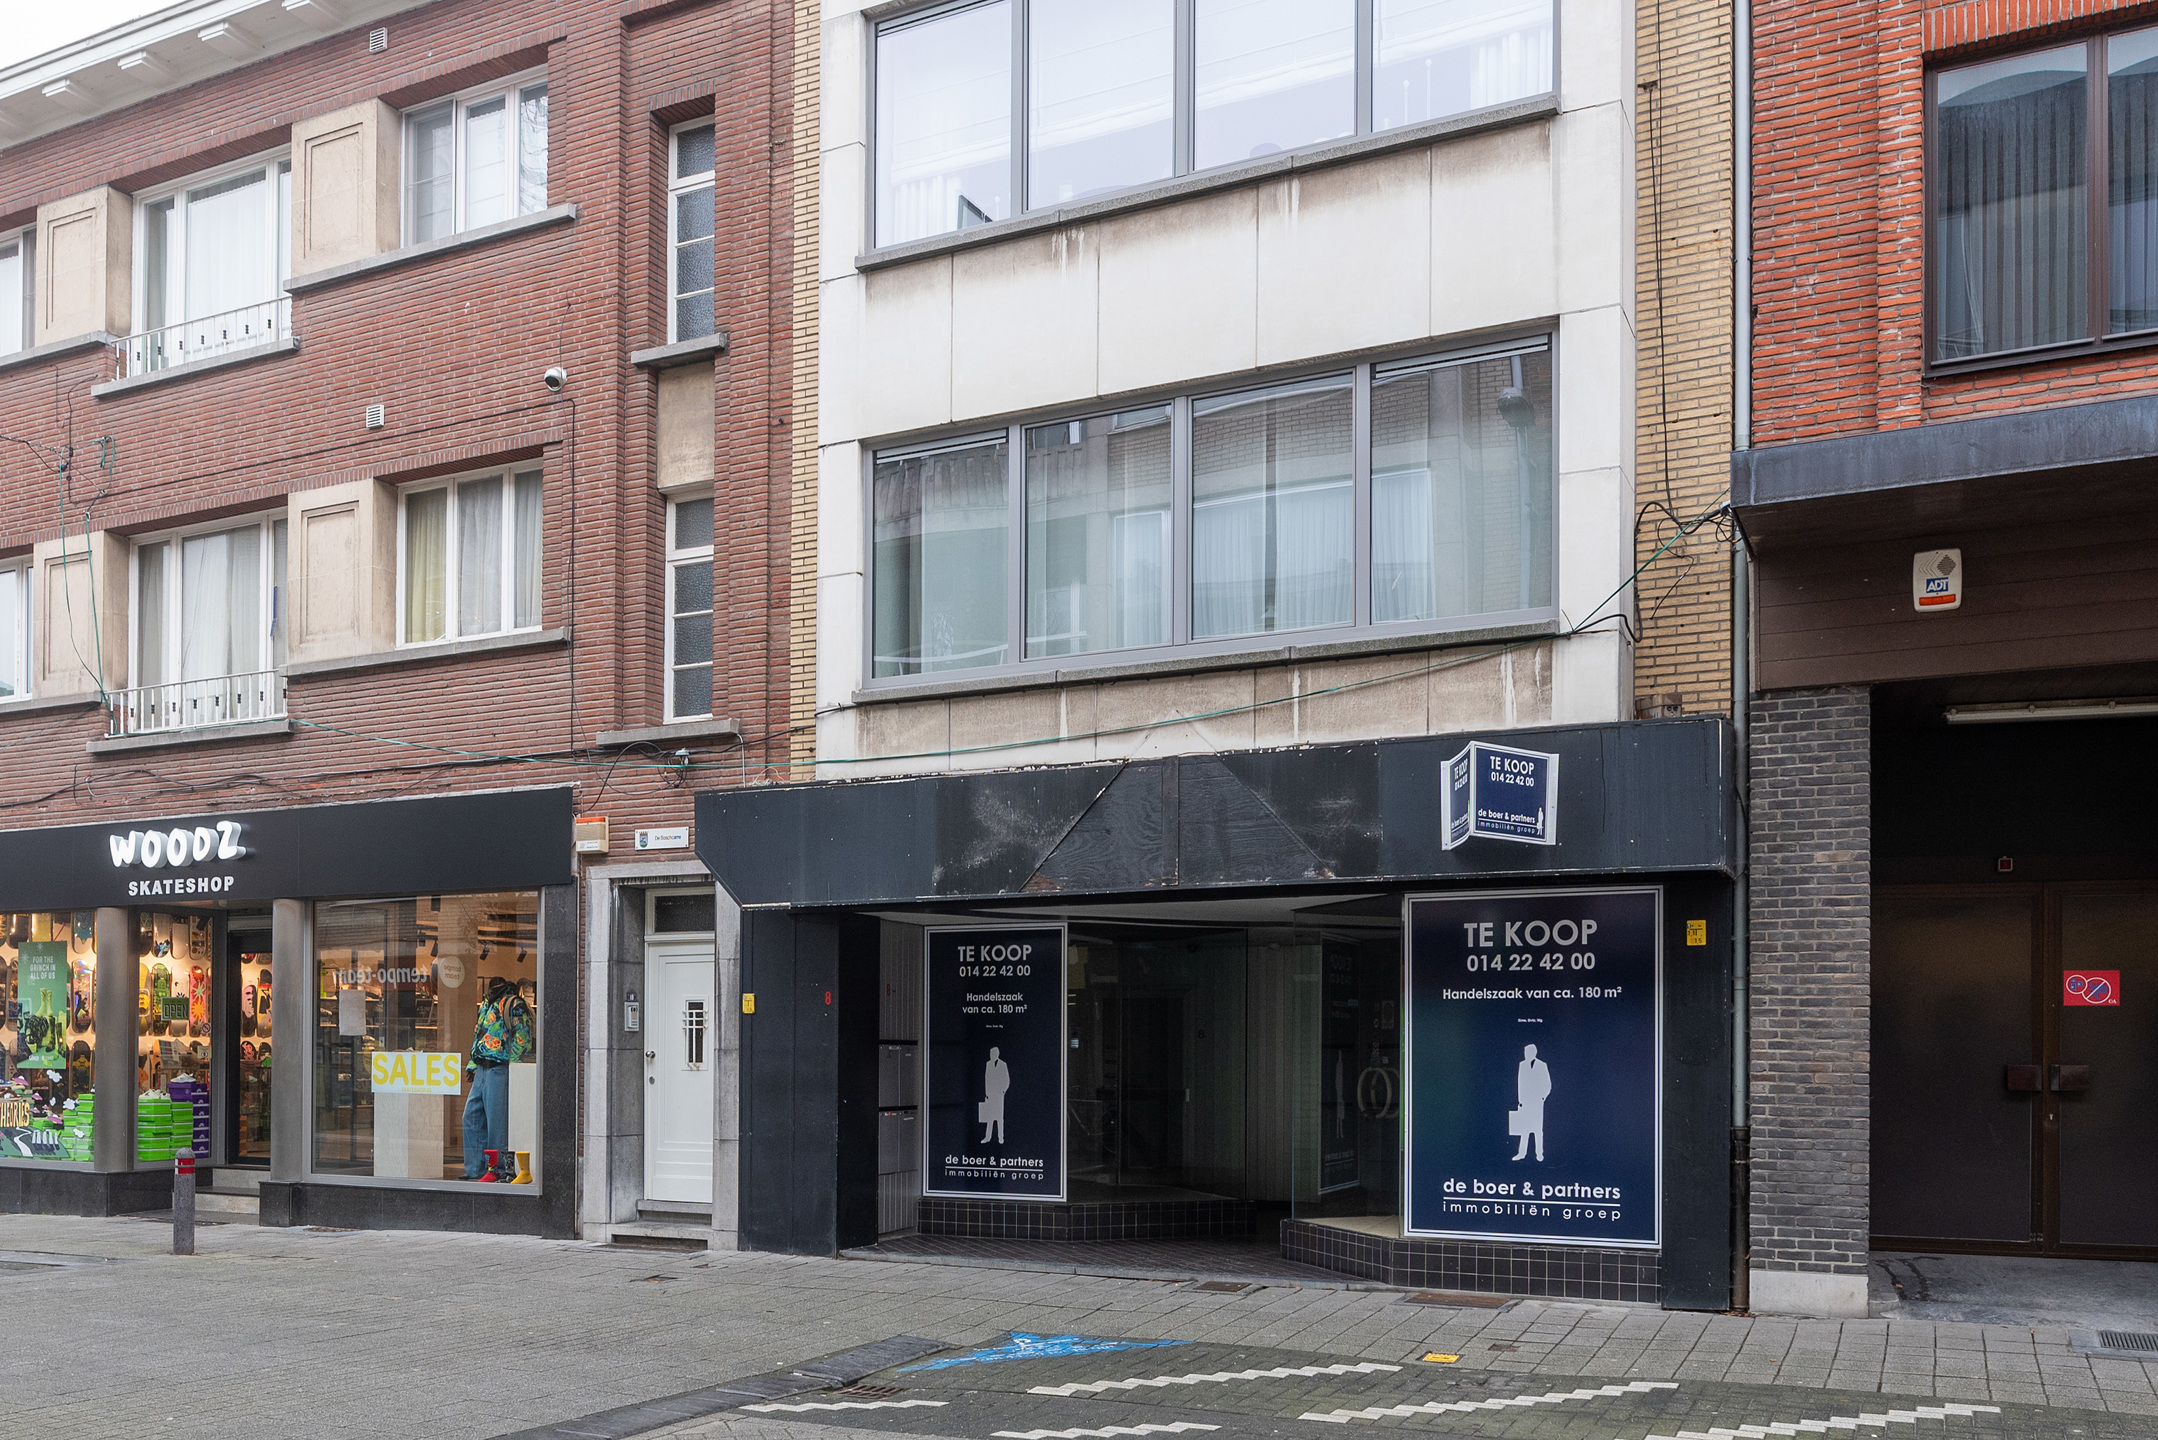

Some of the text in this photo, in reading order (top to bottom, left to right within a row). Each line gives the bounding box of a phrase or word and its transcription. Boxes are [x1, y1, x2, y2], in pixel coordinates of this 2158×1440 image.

[1926, 579, 1949, 592] ADT
[1490, 756, 1535, 775] TE KOOP
[1491, 771, 1534, 787] 014 22 42 00
[1478, 808, 1536, 824] de boer & partners
[109, 820, 246, 868] WOODZ
[128, 876, 235, 897] SKATESHOP
[1463, 919, 1598, 947] TE KOOP
[32, 955, 54, 964] FOR THE
[957, 944, 1032, 962] TE KOOP
[30, 964, 50, 972] GRINCH
[1466, 952, 1596, 972] 014 22 42 00
[959, 965, 1031, 977] 014 22 42 00
[966, 992, 1024, 1002] Handelszaak
[1443, 986, 1622, 1000] Handelszaak van ca. 180 m²
[163, 1003, 188, 1019] OPEN
[962, 1004, 1028, 1014] van ca. 180 m²
[1197, 1029, 1206, 1039] 8
[372, 1053, 460, 1087] SALES
[0, 1101, 30, 1128] HEORIES
[945, 1155, 1044, 1168] de boer & partners
[944, 1168, 1044, 1181] immobiliën groep
[1443, 1178, 1621, 1200] de boer & partners
[1443, 1201, 1621, 1221] immobiliën groep
